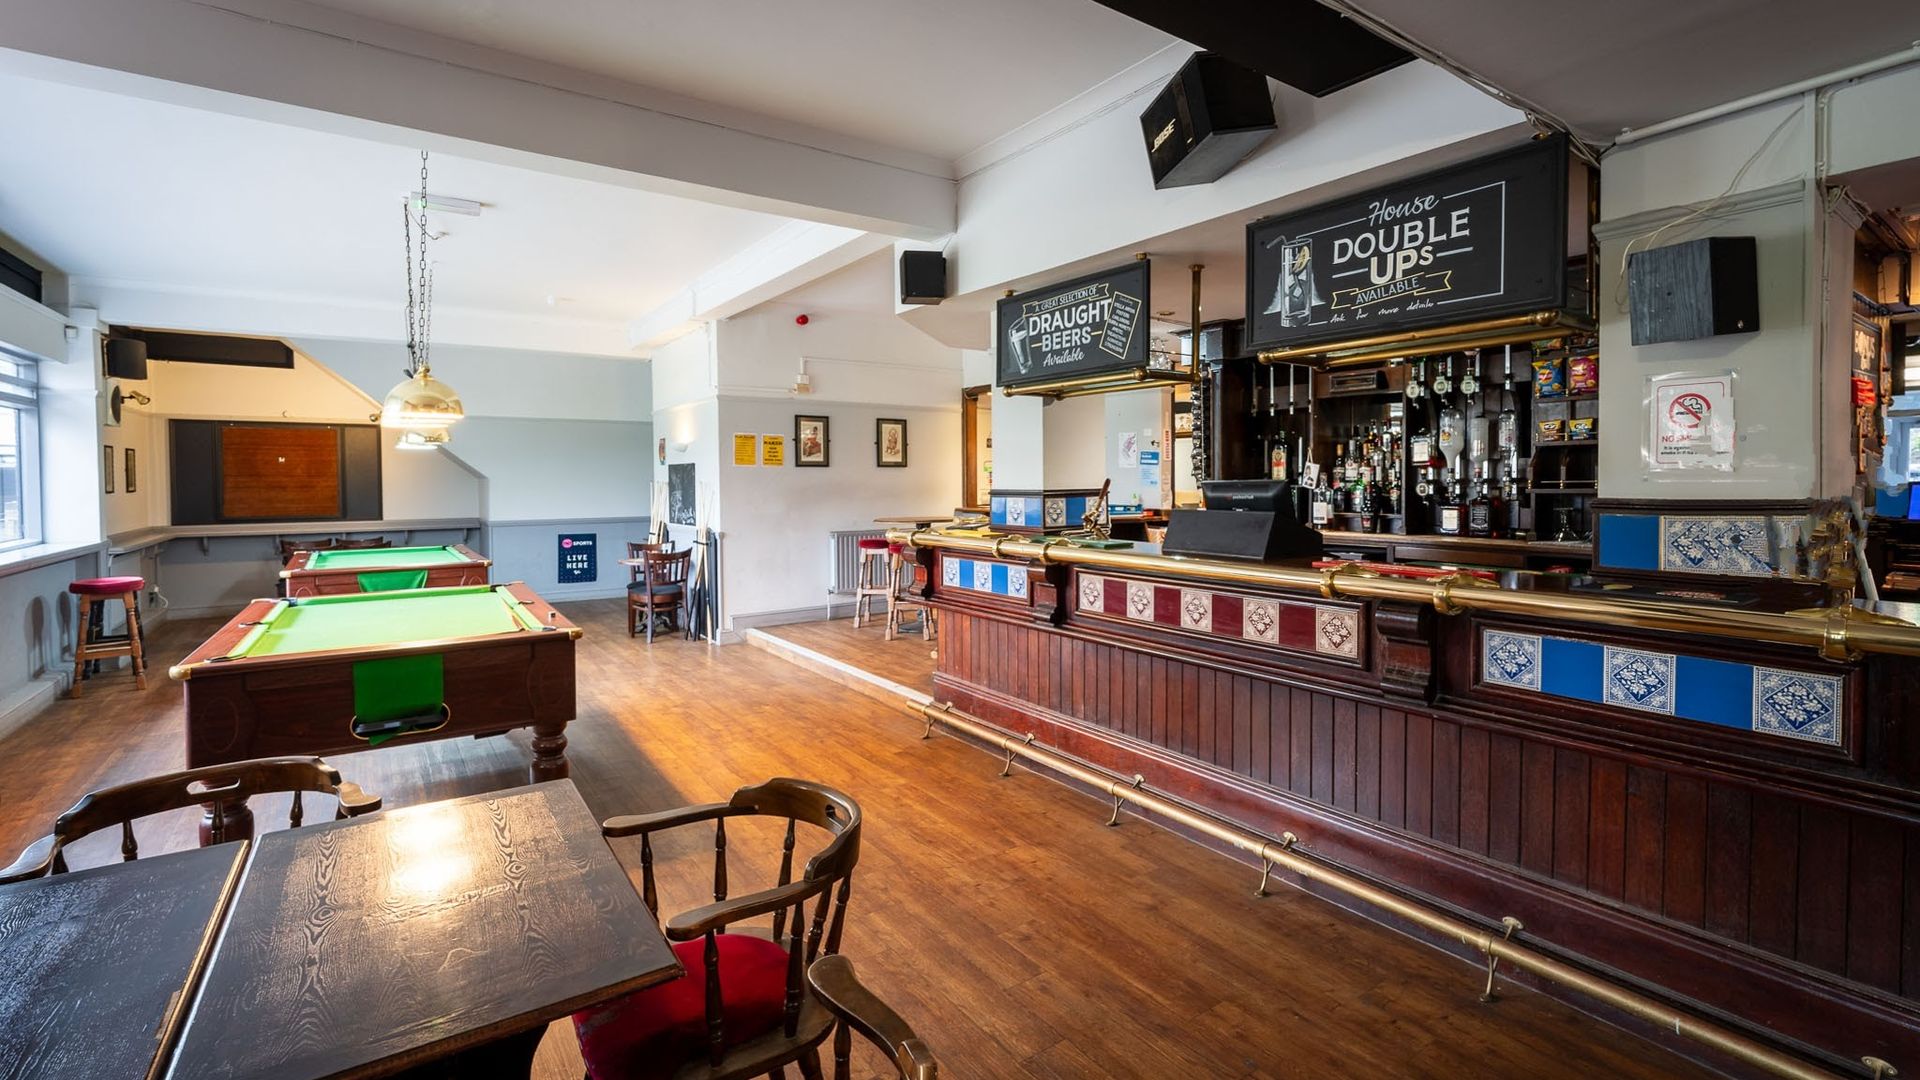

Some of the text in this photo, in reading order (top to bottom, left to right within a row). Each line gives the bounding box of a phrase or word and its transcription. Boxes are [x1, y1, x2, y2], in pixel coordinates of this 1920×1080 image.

[1368, 194, 1440, 227] House
[1332, 206, 1471, 265] DOUBLE
[1041, 299, 1059, 311] GREAT
[1059, 289, 1088, 305] SELECTION
[1088, 285, 1097, 296] OF
[1355, 276, 1420, 305] AVAILABLE
[1028, 298, 1112, 337] DRAUGHT
[1330, 313, 1346, 323] Ask
[1378, 306, 1400, 316] more
[1042, 326, 1092, 352] BEERS
[1043, 347, 1085, 367] Available
[1661, 435, 1675, 443] NO
